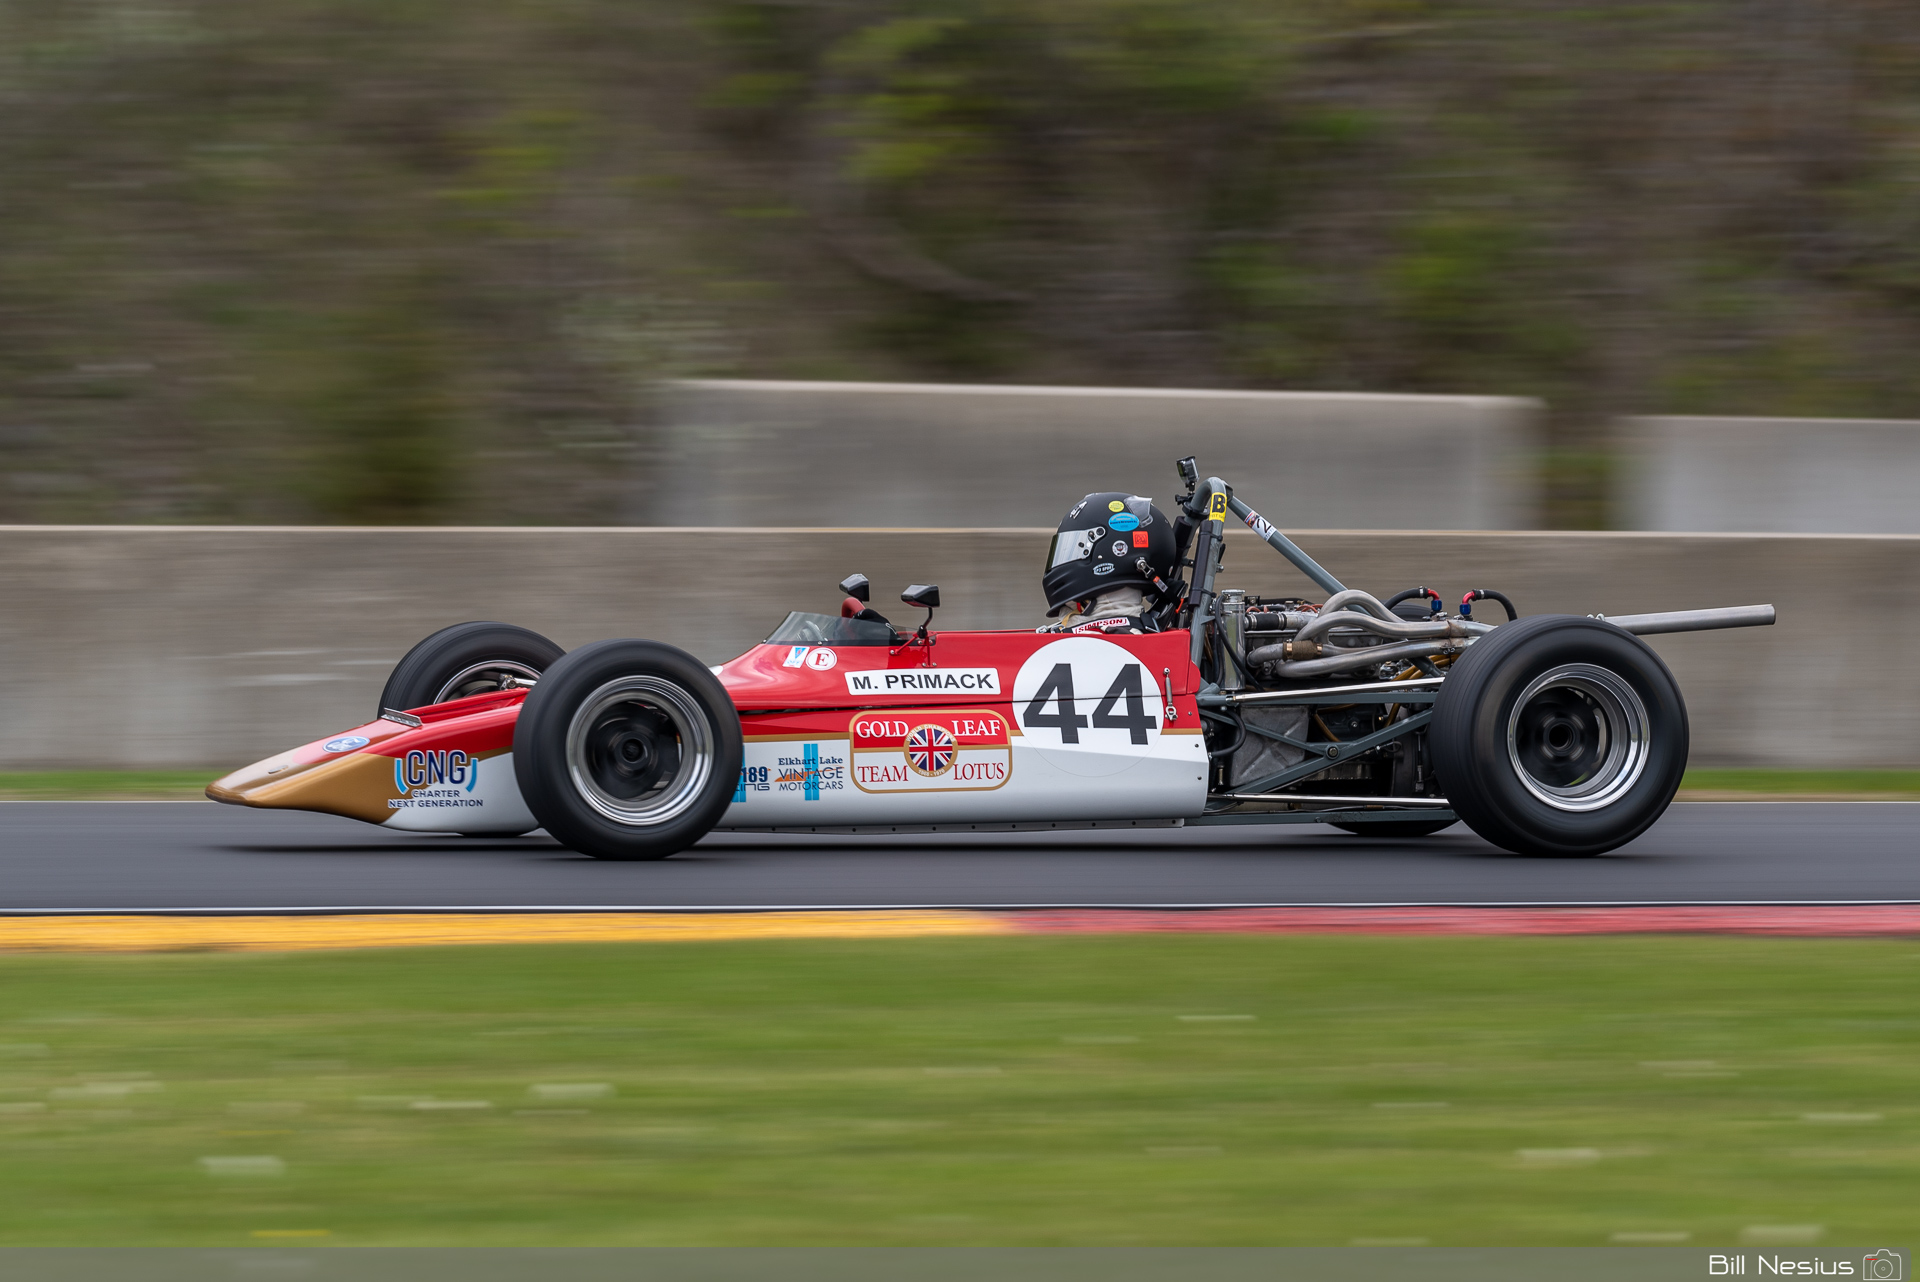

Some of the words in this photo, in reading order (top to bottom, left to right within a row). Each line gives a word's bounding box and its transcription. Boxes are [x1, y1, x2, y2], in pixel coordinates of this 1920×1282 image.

[1212, 494, 1226, 513] B
[1078, 618, 1123, 632] SIMPSON
[815, 653, 829, 666] E
[853, 676, 878, 690] M.
[885, 673, 994, 689] PRIMACK
[1023, 663, 1157, 745] 44
[856, 720, 909, 738] GOLD
[952, 719, 1000, 736] LEAF
[778, 757, 816, 765] Elkhart
[819, 756, 844, 765] Lake
[407, 750, 467, 785] CNG
[778, 767, 844, 780] VINTAGE
[857, 765, 909, 783] TEAM
[953, 762, 1005, 780] LOTUS
[735, 782, 770, 791] ING
[778, 781, 844, 791] MOTORCARS
[411, 789, 460, 798] CHARTER
[388, 799, 415, 808] NEXT
[418, 799, 483, 808] GENERATION
